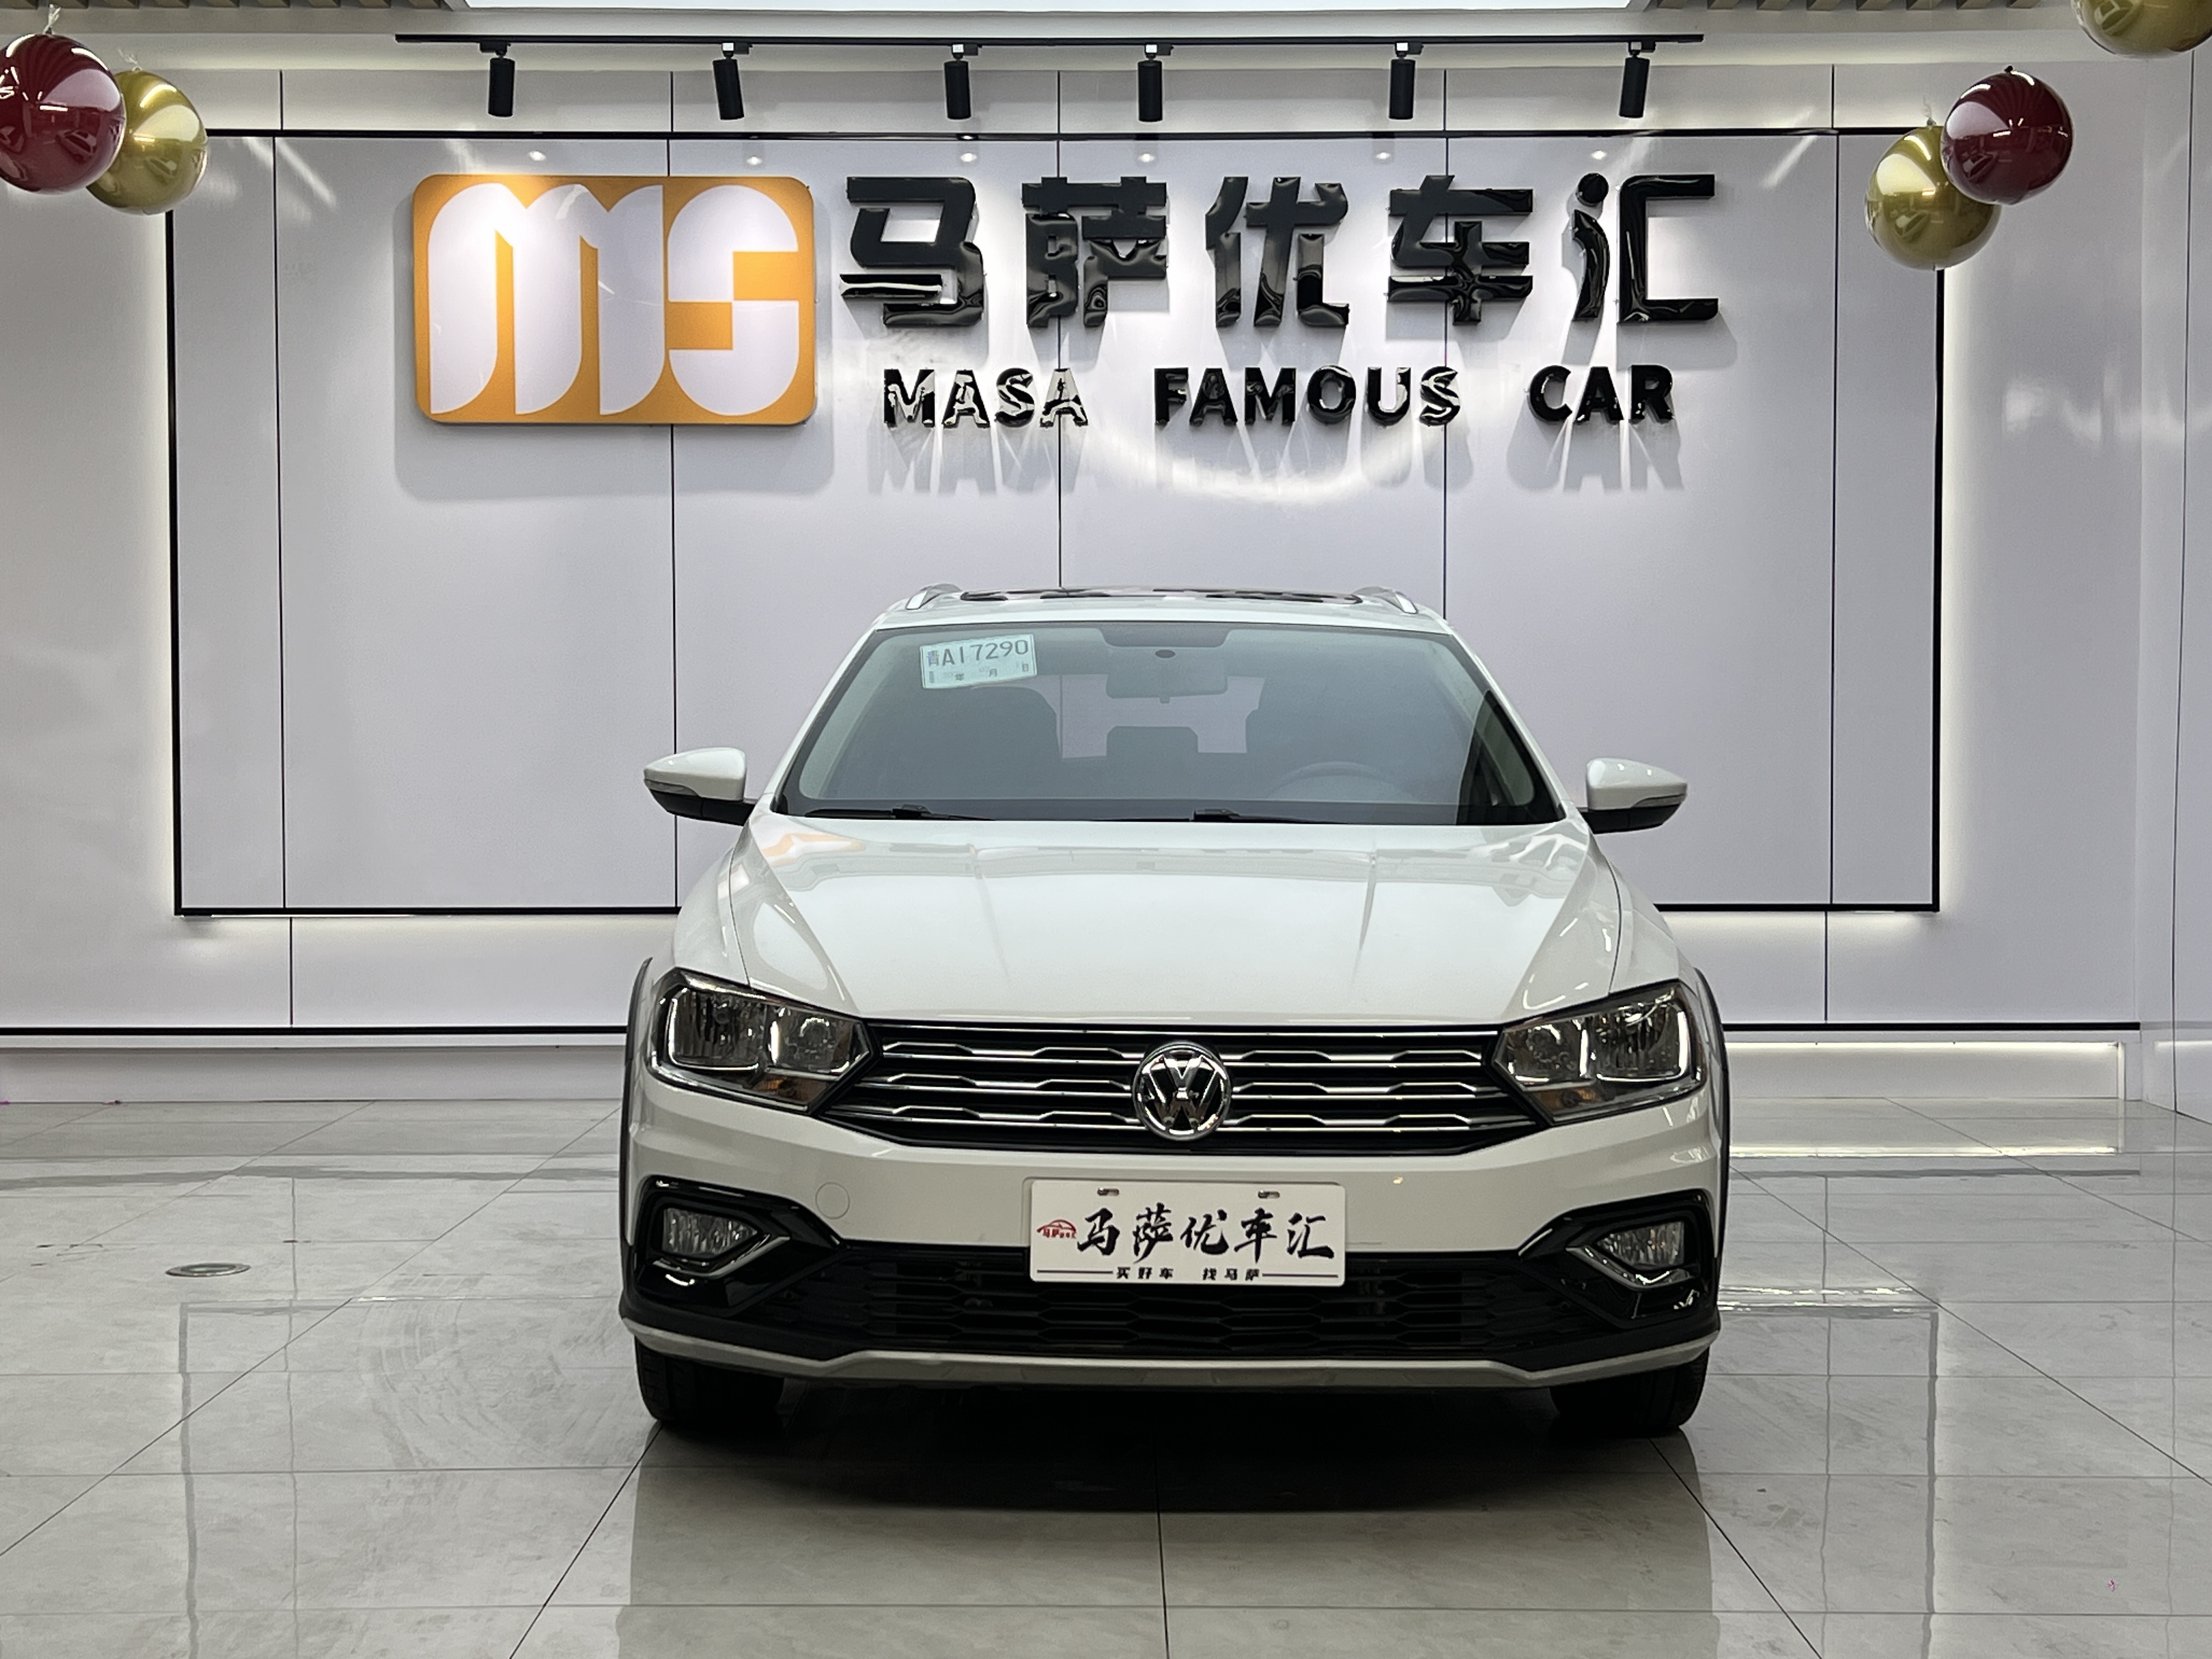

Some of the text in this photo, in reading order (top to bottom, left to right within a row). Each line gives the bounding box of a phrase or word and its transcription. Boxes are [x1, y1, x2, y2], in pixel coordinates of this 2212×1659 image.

[840, 173, 1718, 328] 马萨优车汇
[884, 364, 1674, 428] MASA FAMOUS CAR
[1077, 1203, 1334, 1263] 马萨优车汇
[1116, 1266, 1260, 1282] 买好车 找马萨
